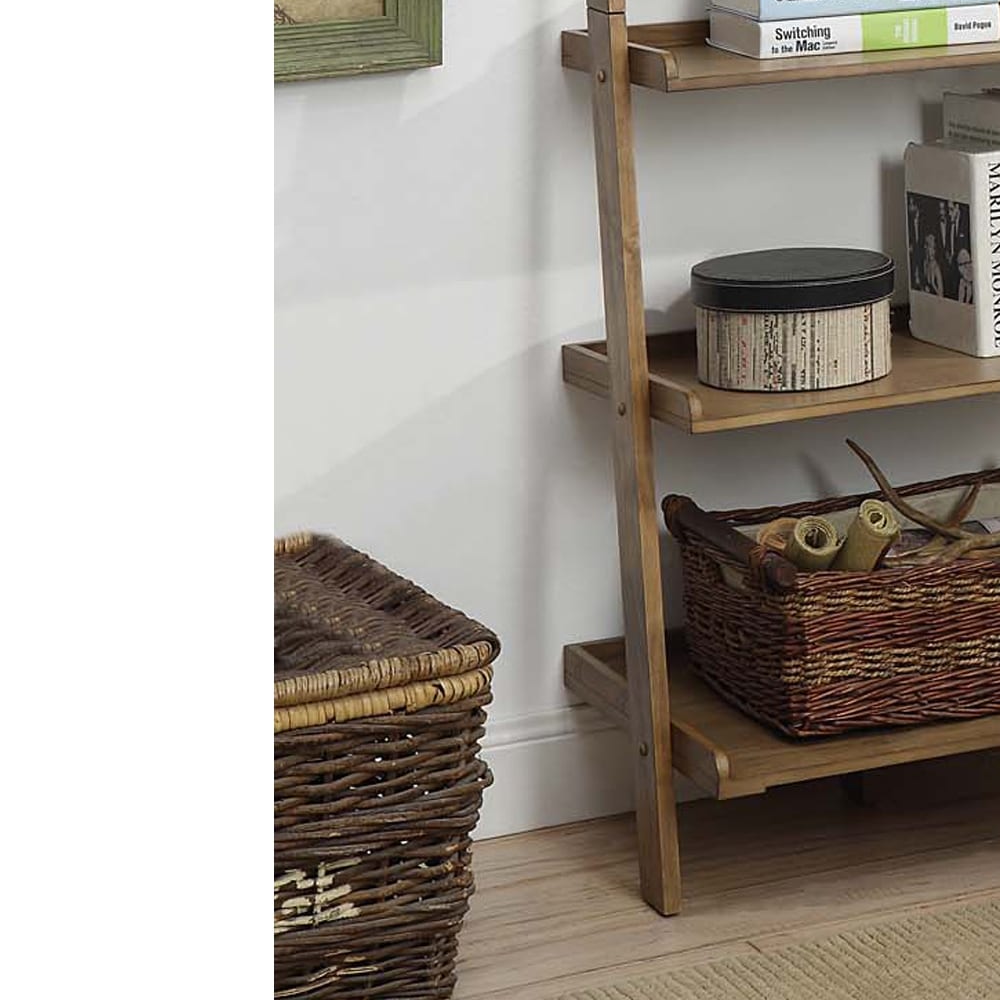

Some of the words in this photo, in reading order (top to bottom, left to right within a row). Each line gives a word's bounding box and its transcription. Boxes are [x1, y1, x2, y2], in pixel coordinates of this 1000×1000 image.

[775, 25, 831, 40] Switching
[954, 22, 971, 30] David
[771, 45, 779, 54] to
[781, 44, 794, 53] the
[795, 39, 820, 52] Mac
